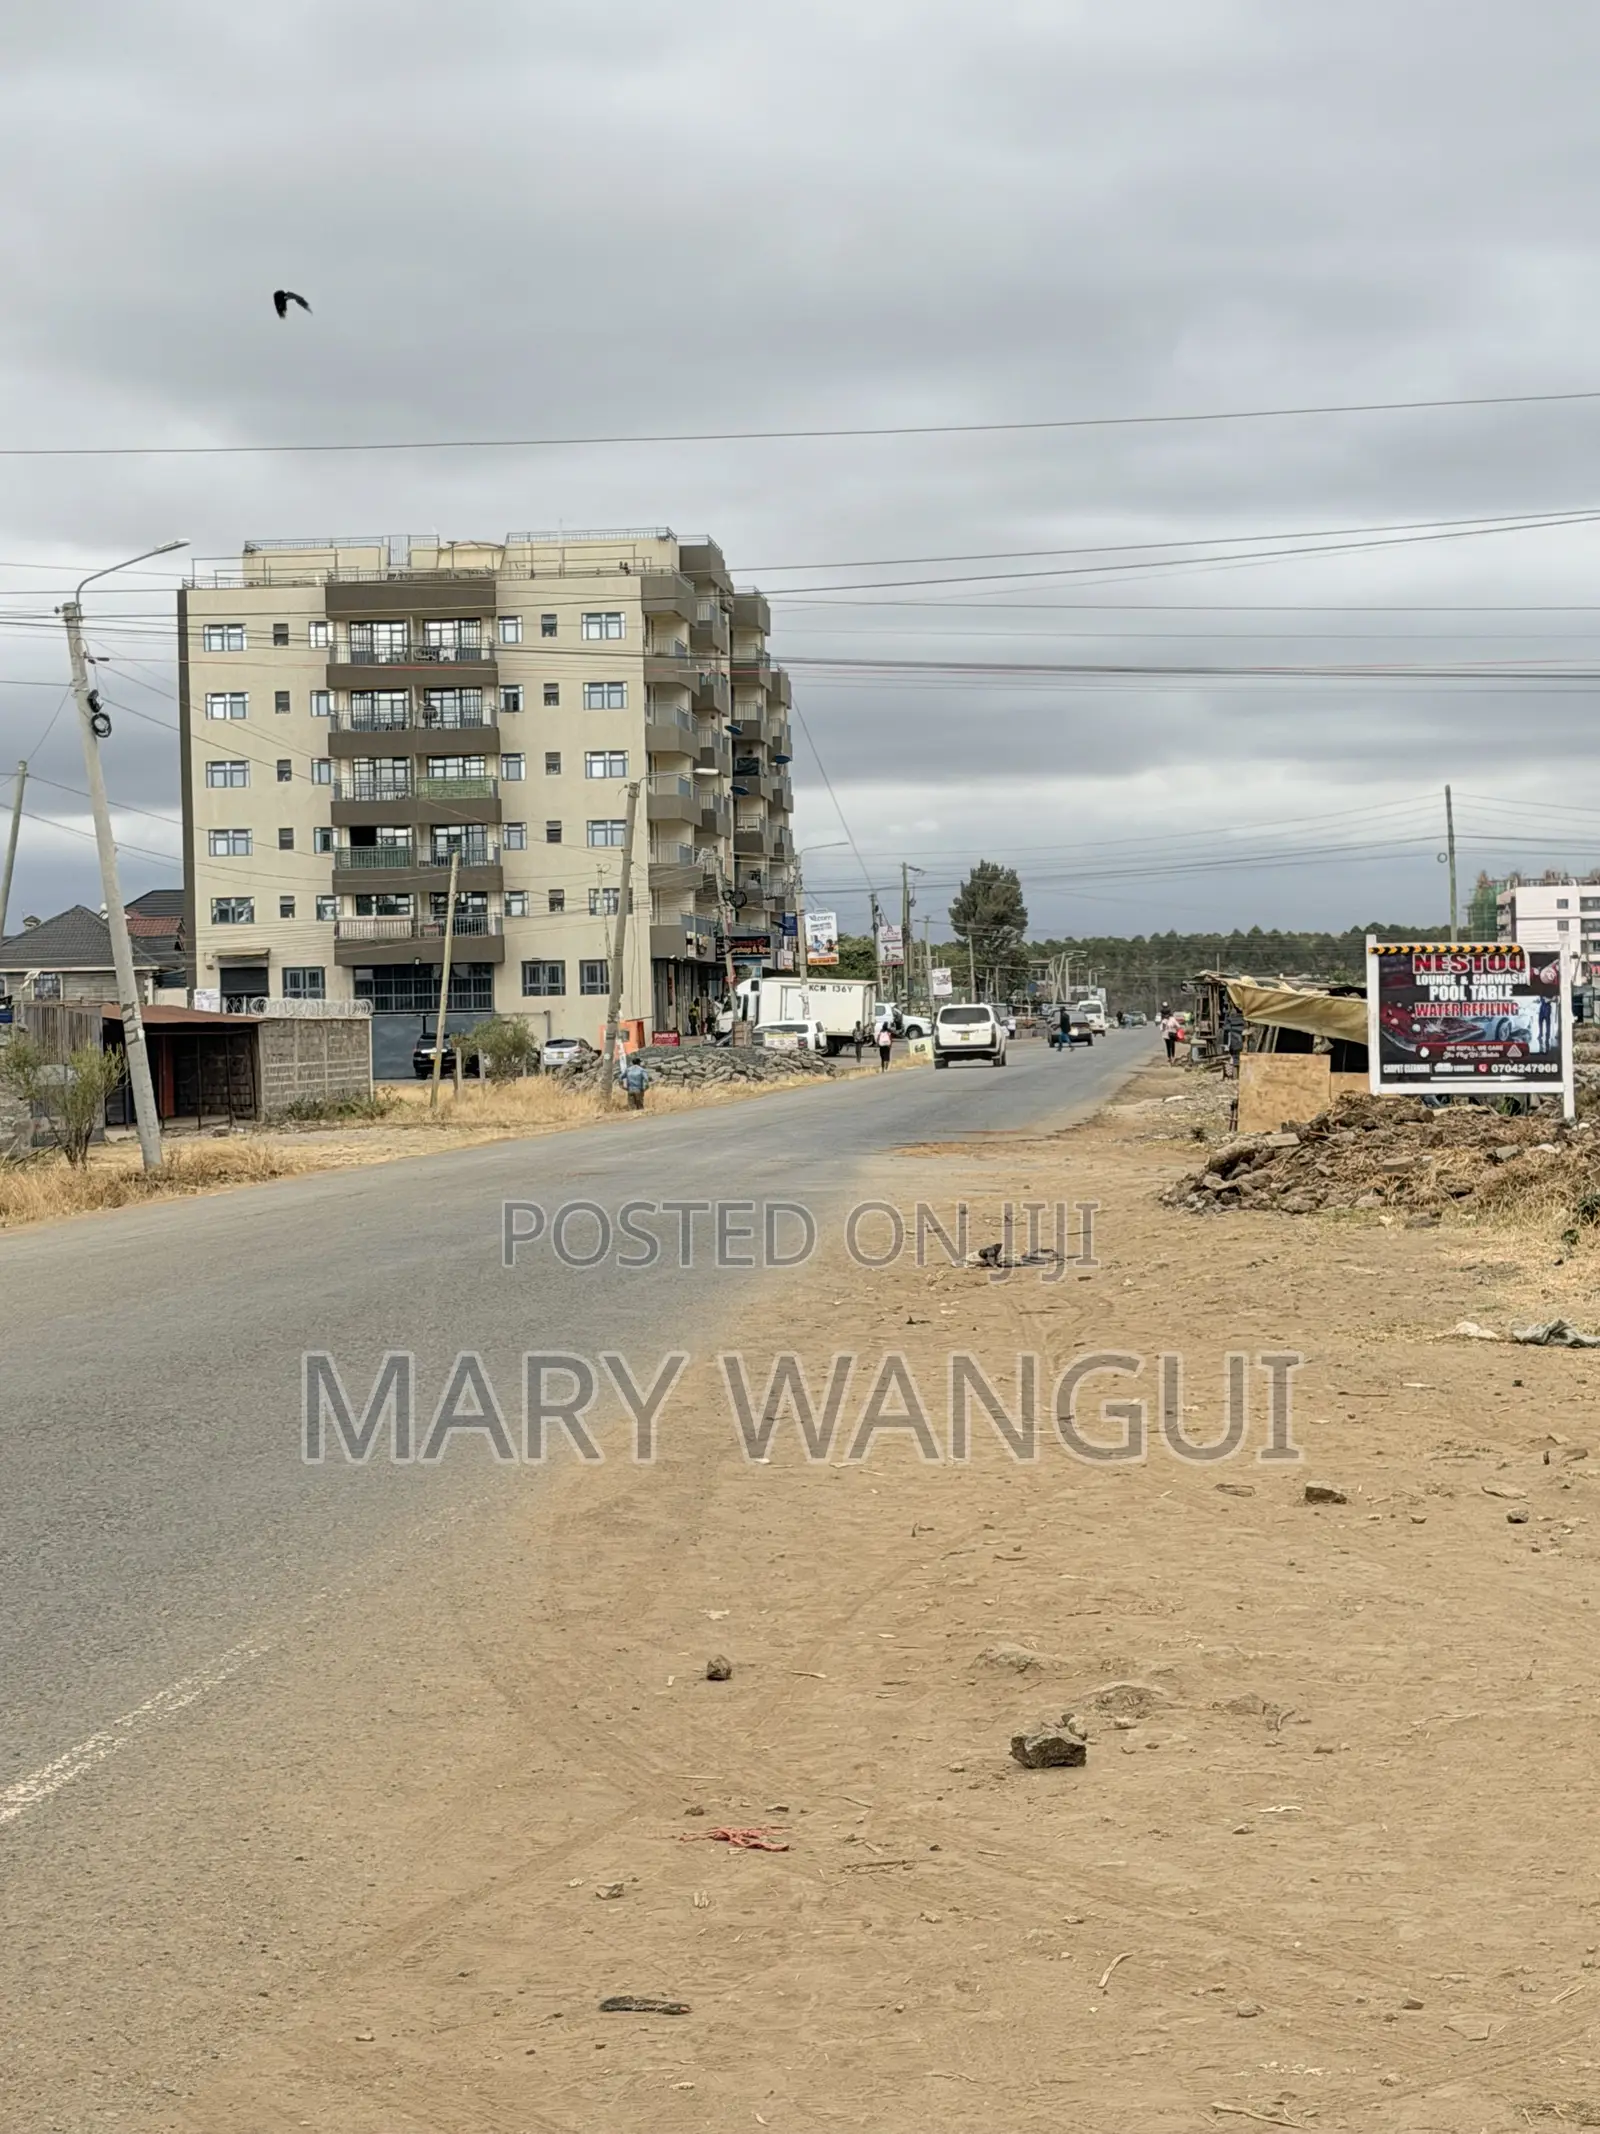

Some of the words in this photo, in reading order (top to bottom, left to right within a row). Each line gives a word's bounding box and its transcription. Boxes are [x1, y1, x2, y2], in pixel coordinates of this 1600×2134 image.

[1416, 974, 1456, 985] LOUNGE
[1460, 975, 1469, 985] &
[1472, 973, 1527, 985] CARWASH
[808, 984, 827, 992] KCM
[832, 985, 853, 993] 136Y
[1429, 985, 1467, 1001] POOL
[1469, 985, 1513, 1001] TABLE
[1414, 1002, 1460, 1017] WATER
[1461, 1002, 1519, 1017] REFILING
